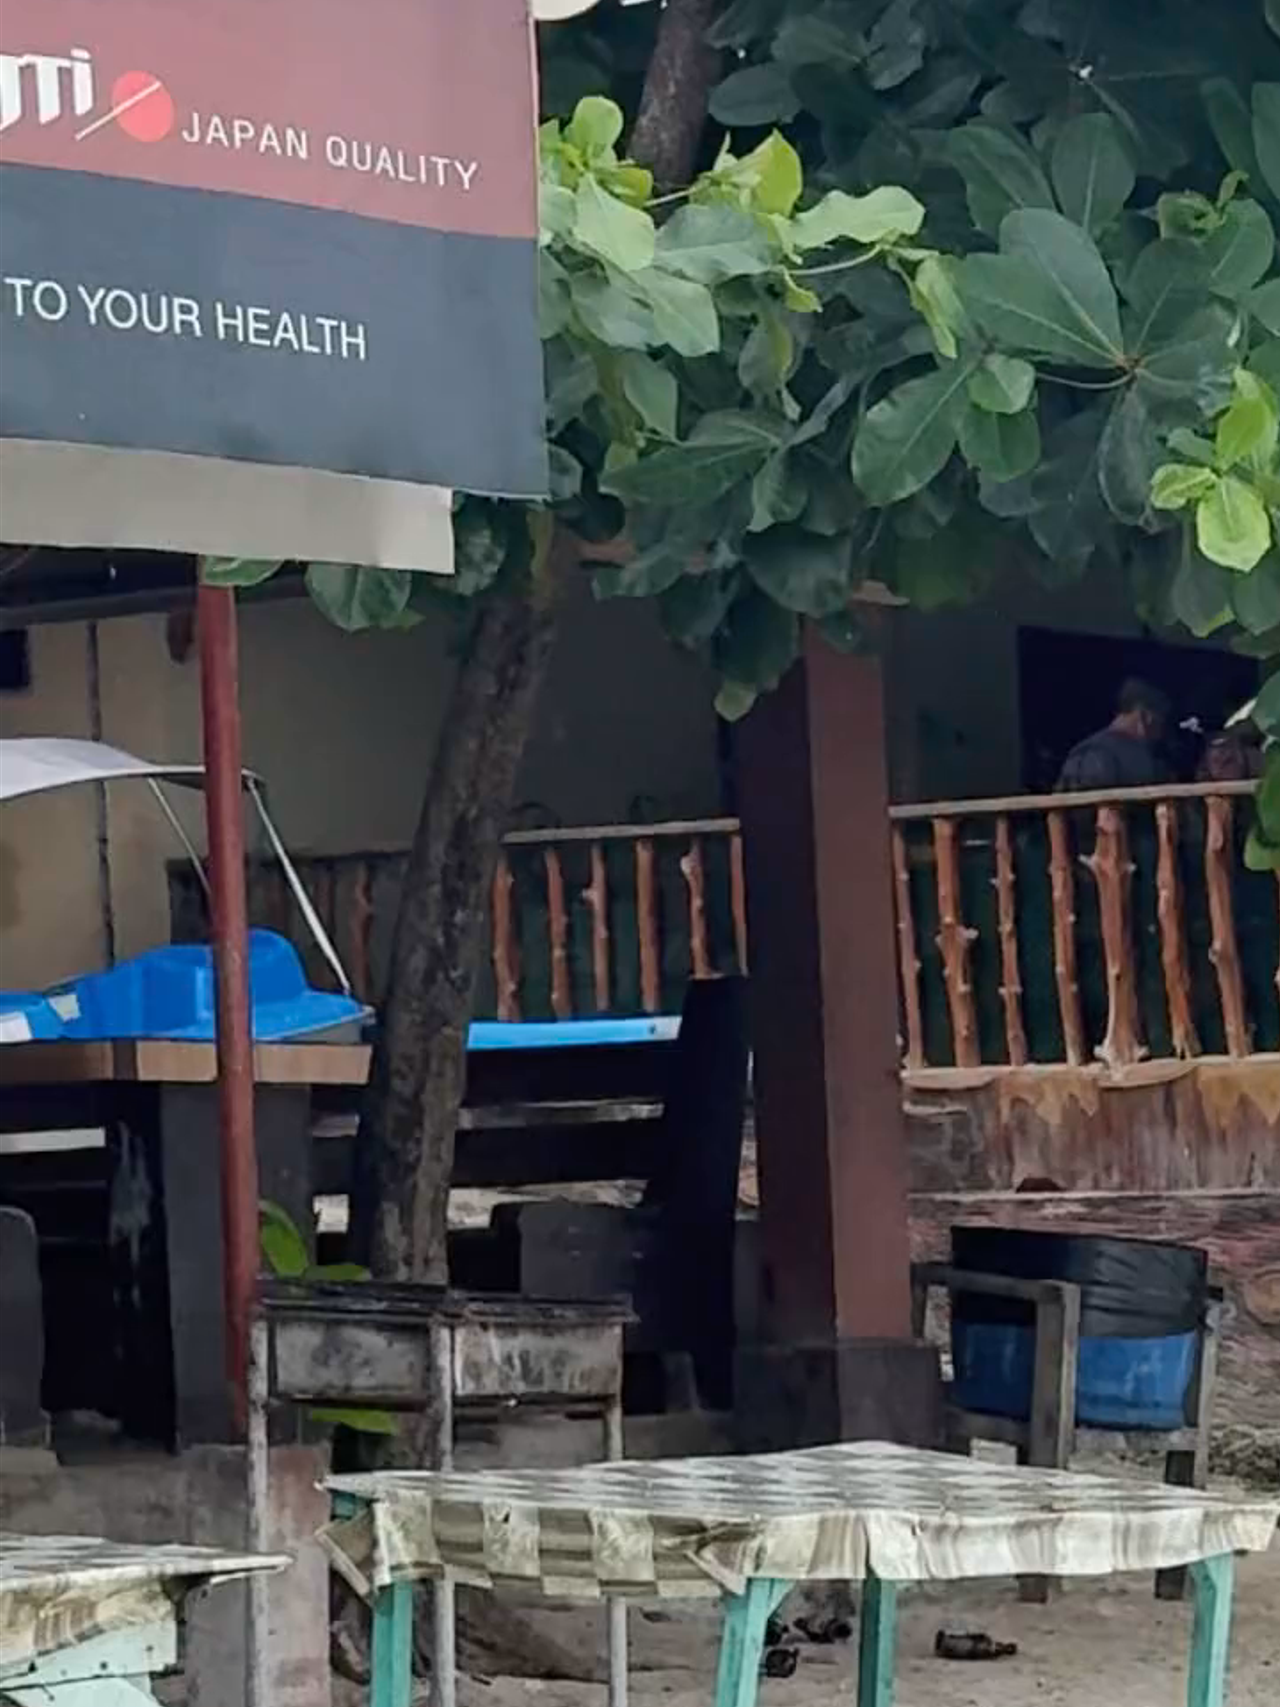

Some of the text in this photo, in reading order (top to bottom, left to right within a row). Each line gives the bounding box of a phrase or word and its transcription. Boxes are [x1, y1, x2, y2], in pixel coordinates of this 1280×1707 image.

[182, 111, 479, 191] JAPAN QUALITY
[4, 277, 367, 361] TO YOUR HEALTH
